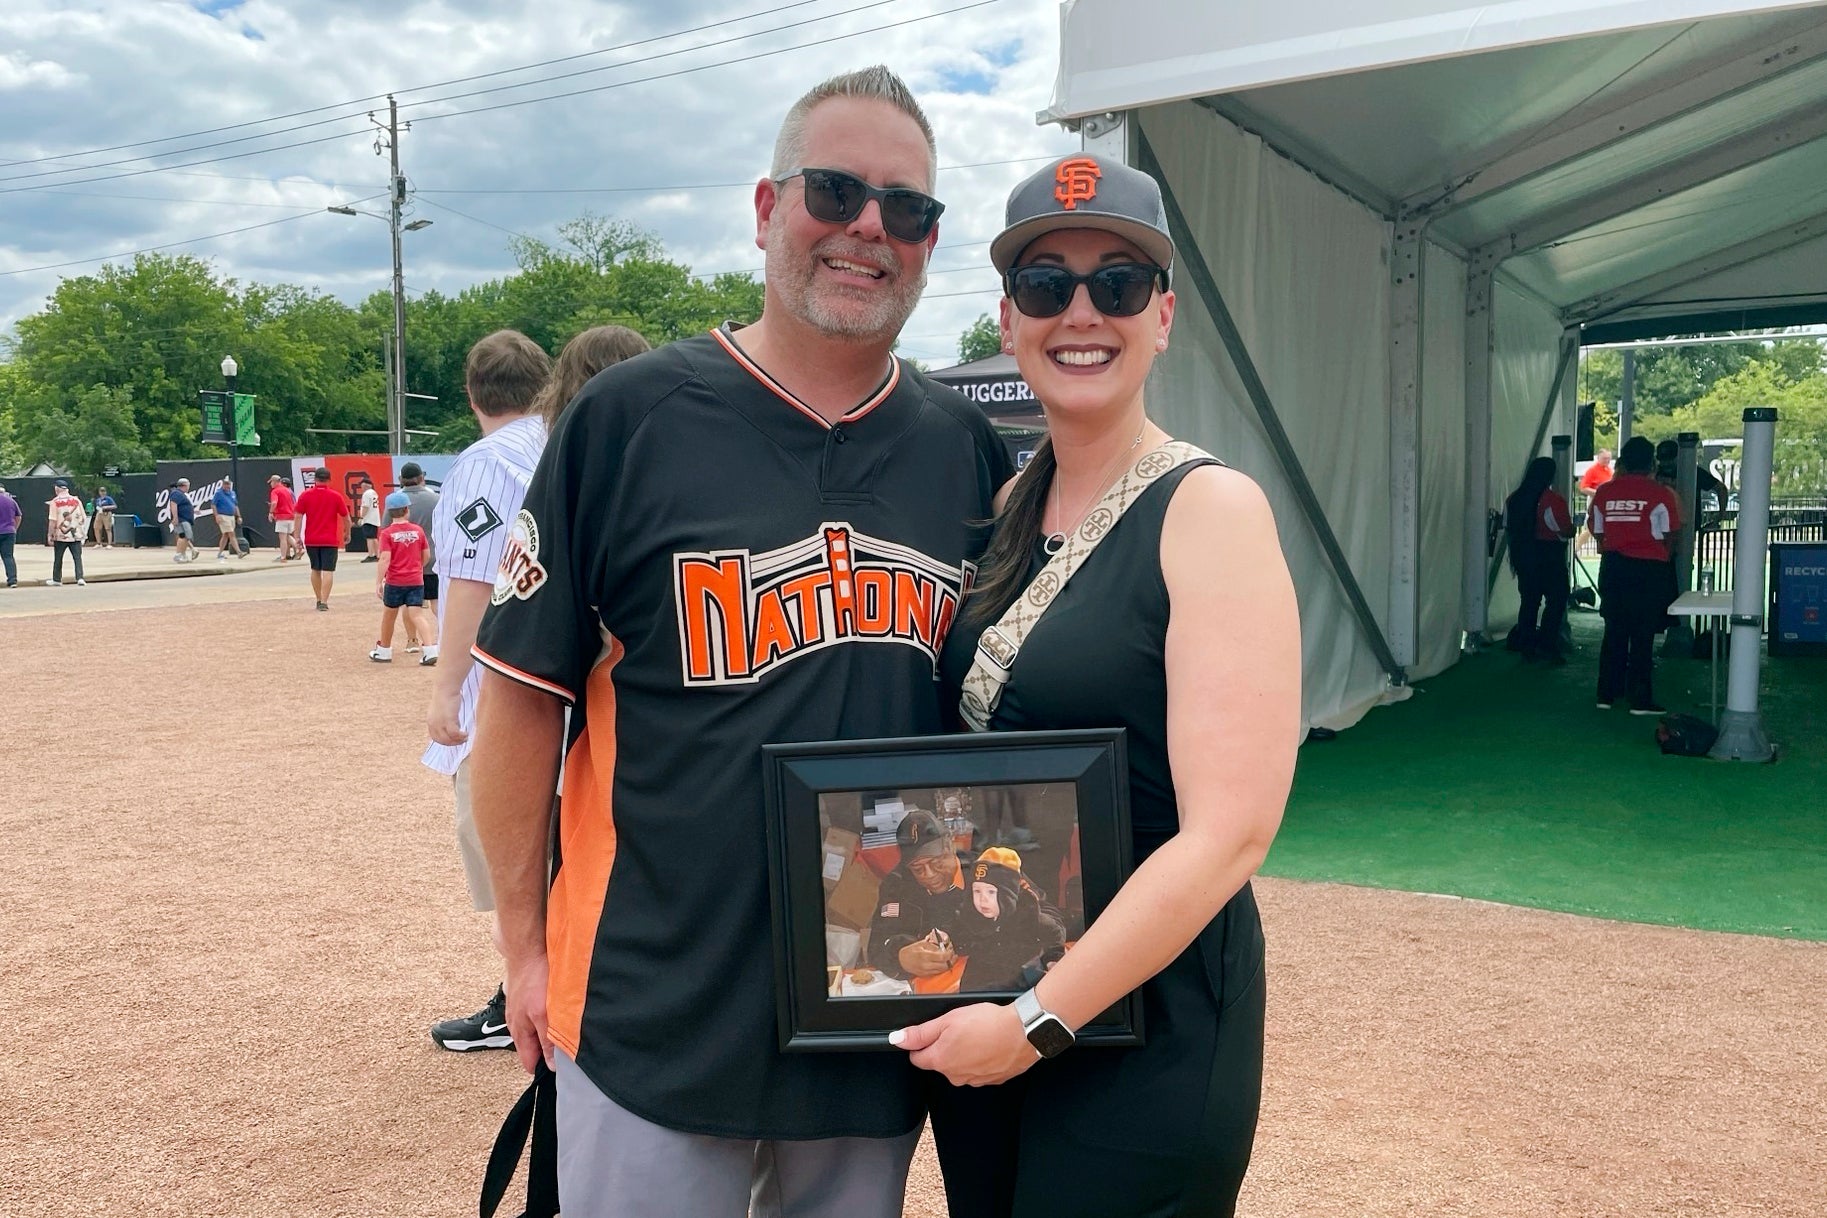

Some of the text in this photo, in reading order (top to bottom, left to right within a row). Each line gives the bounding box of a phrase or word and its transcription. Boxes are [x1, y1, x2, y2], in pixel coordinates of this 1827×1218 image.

[1054, 158, 1102, 211] SF
[952, 381, 1036, 403] UGGER
[1605, 500, 1648, 511] BEST
[1784, 566, 1827, 576] RECYC
[673, 521, 978, 688] NATIONA
